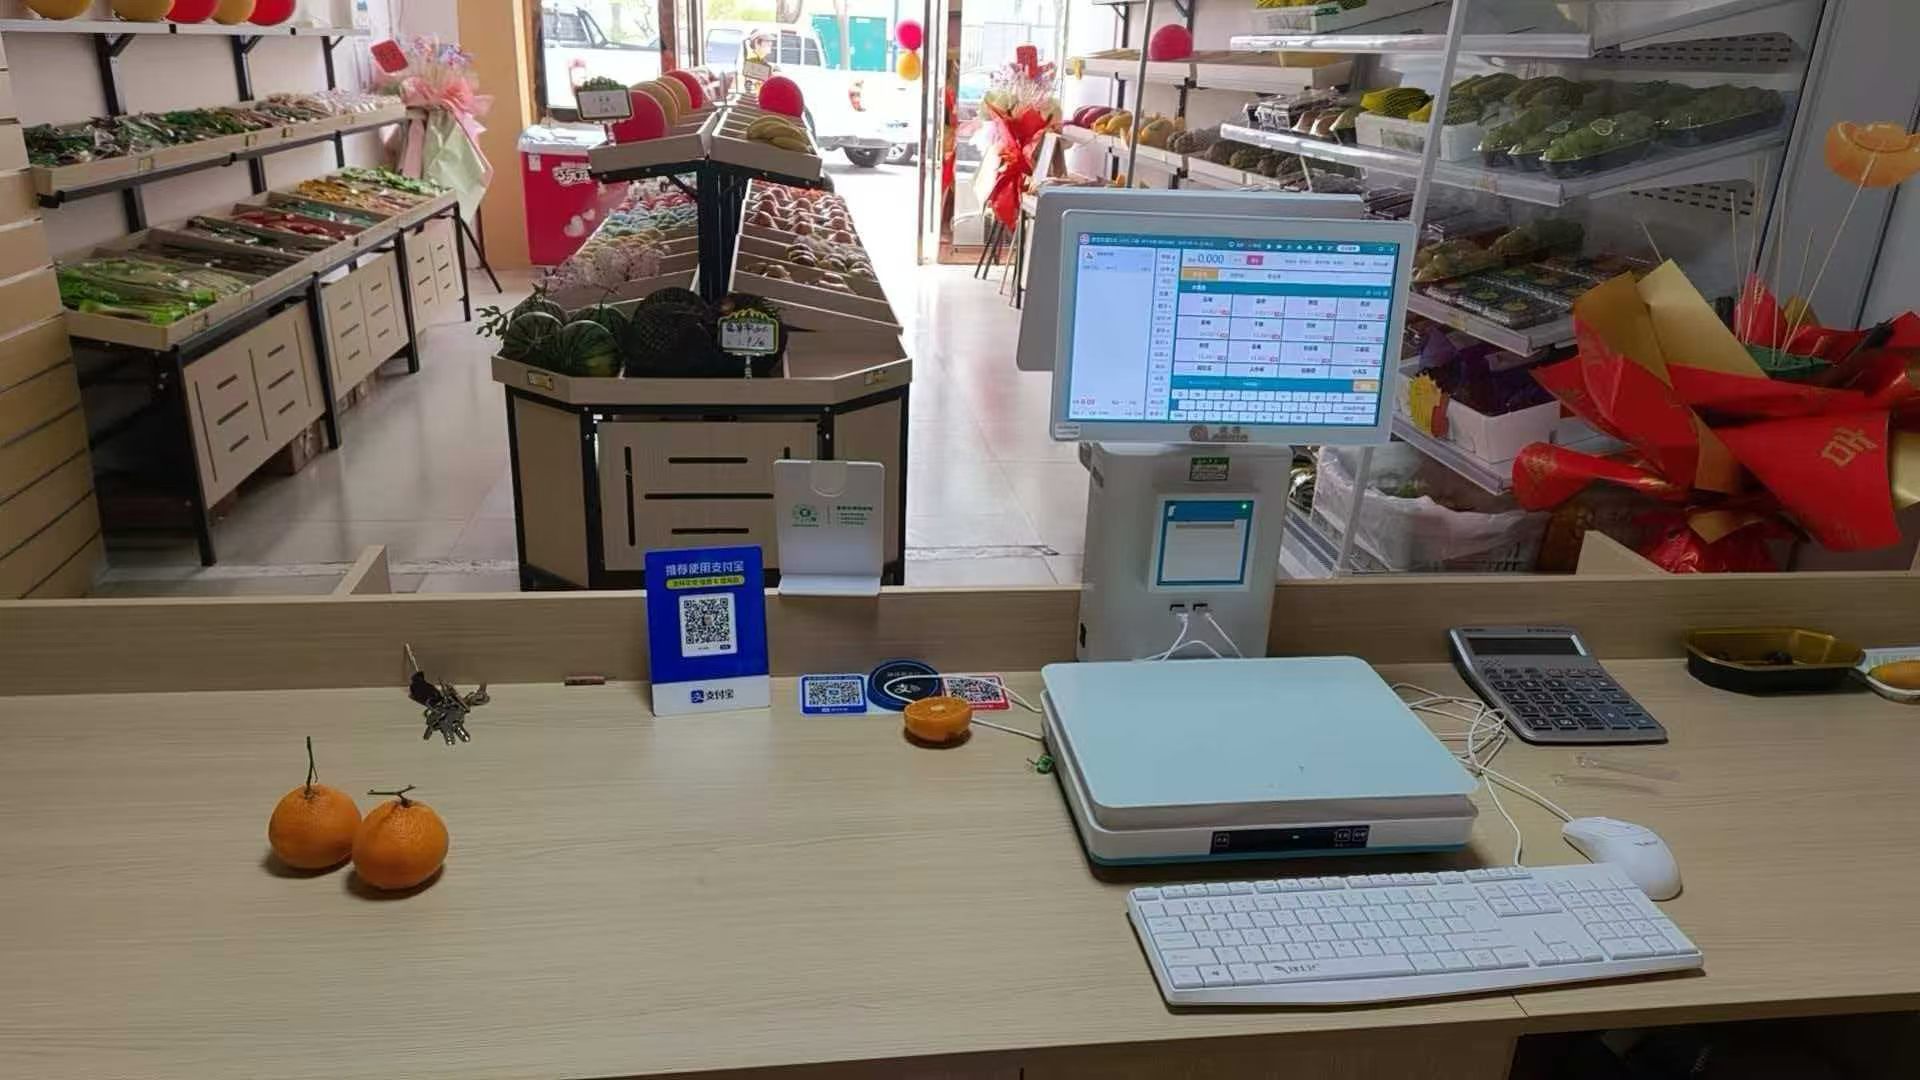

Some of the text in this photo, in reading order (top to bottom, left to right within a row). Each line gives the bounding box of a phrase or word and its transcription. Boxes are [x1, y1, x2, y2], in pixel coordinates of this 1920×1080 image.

[1198, 254, 1225, 265] 0.000
[665, 561, 745, 576] 推荐使用支付宝
[705, 688, 734, 701] 支付宝
